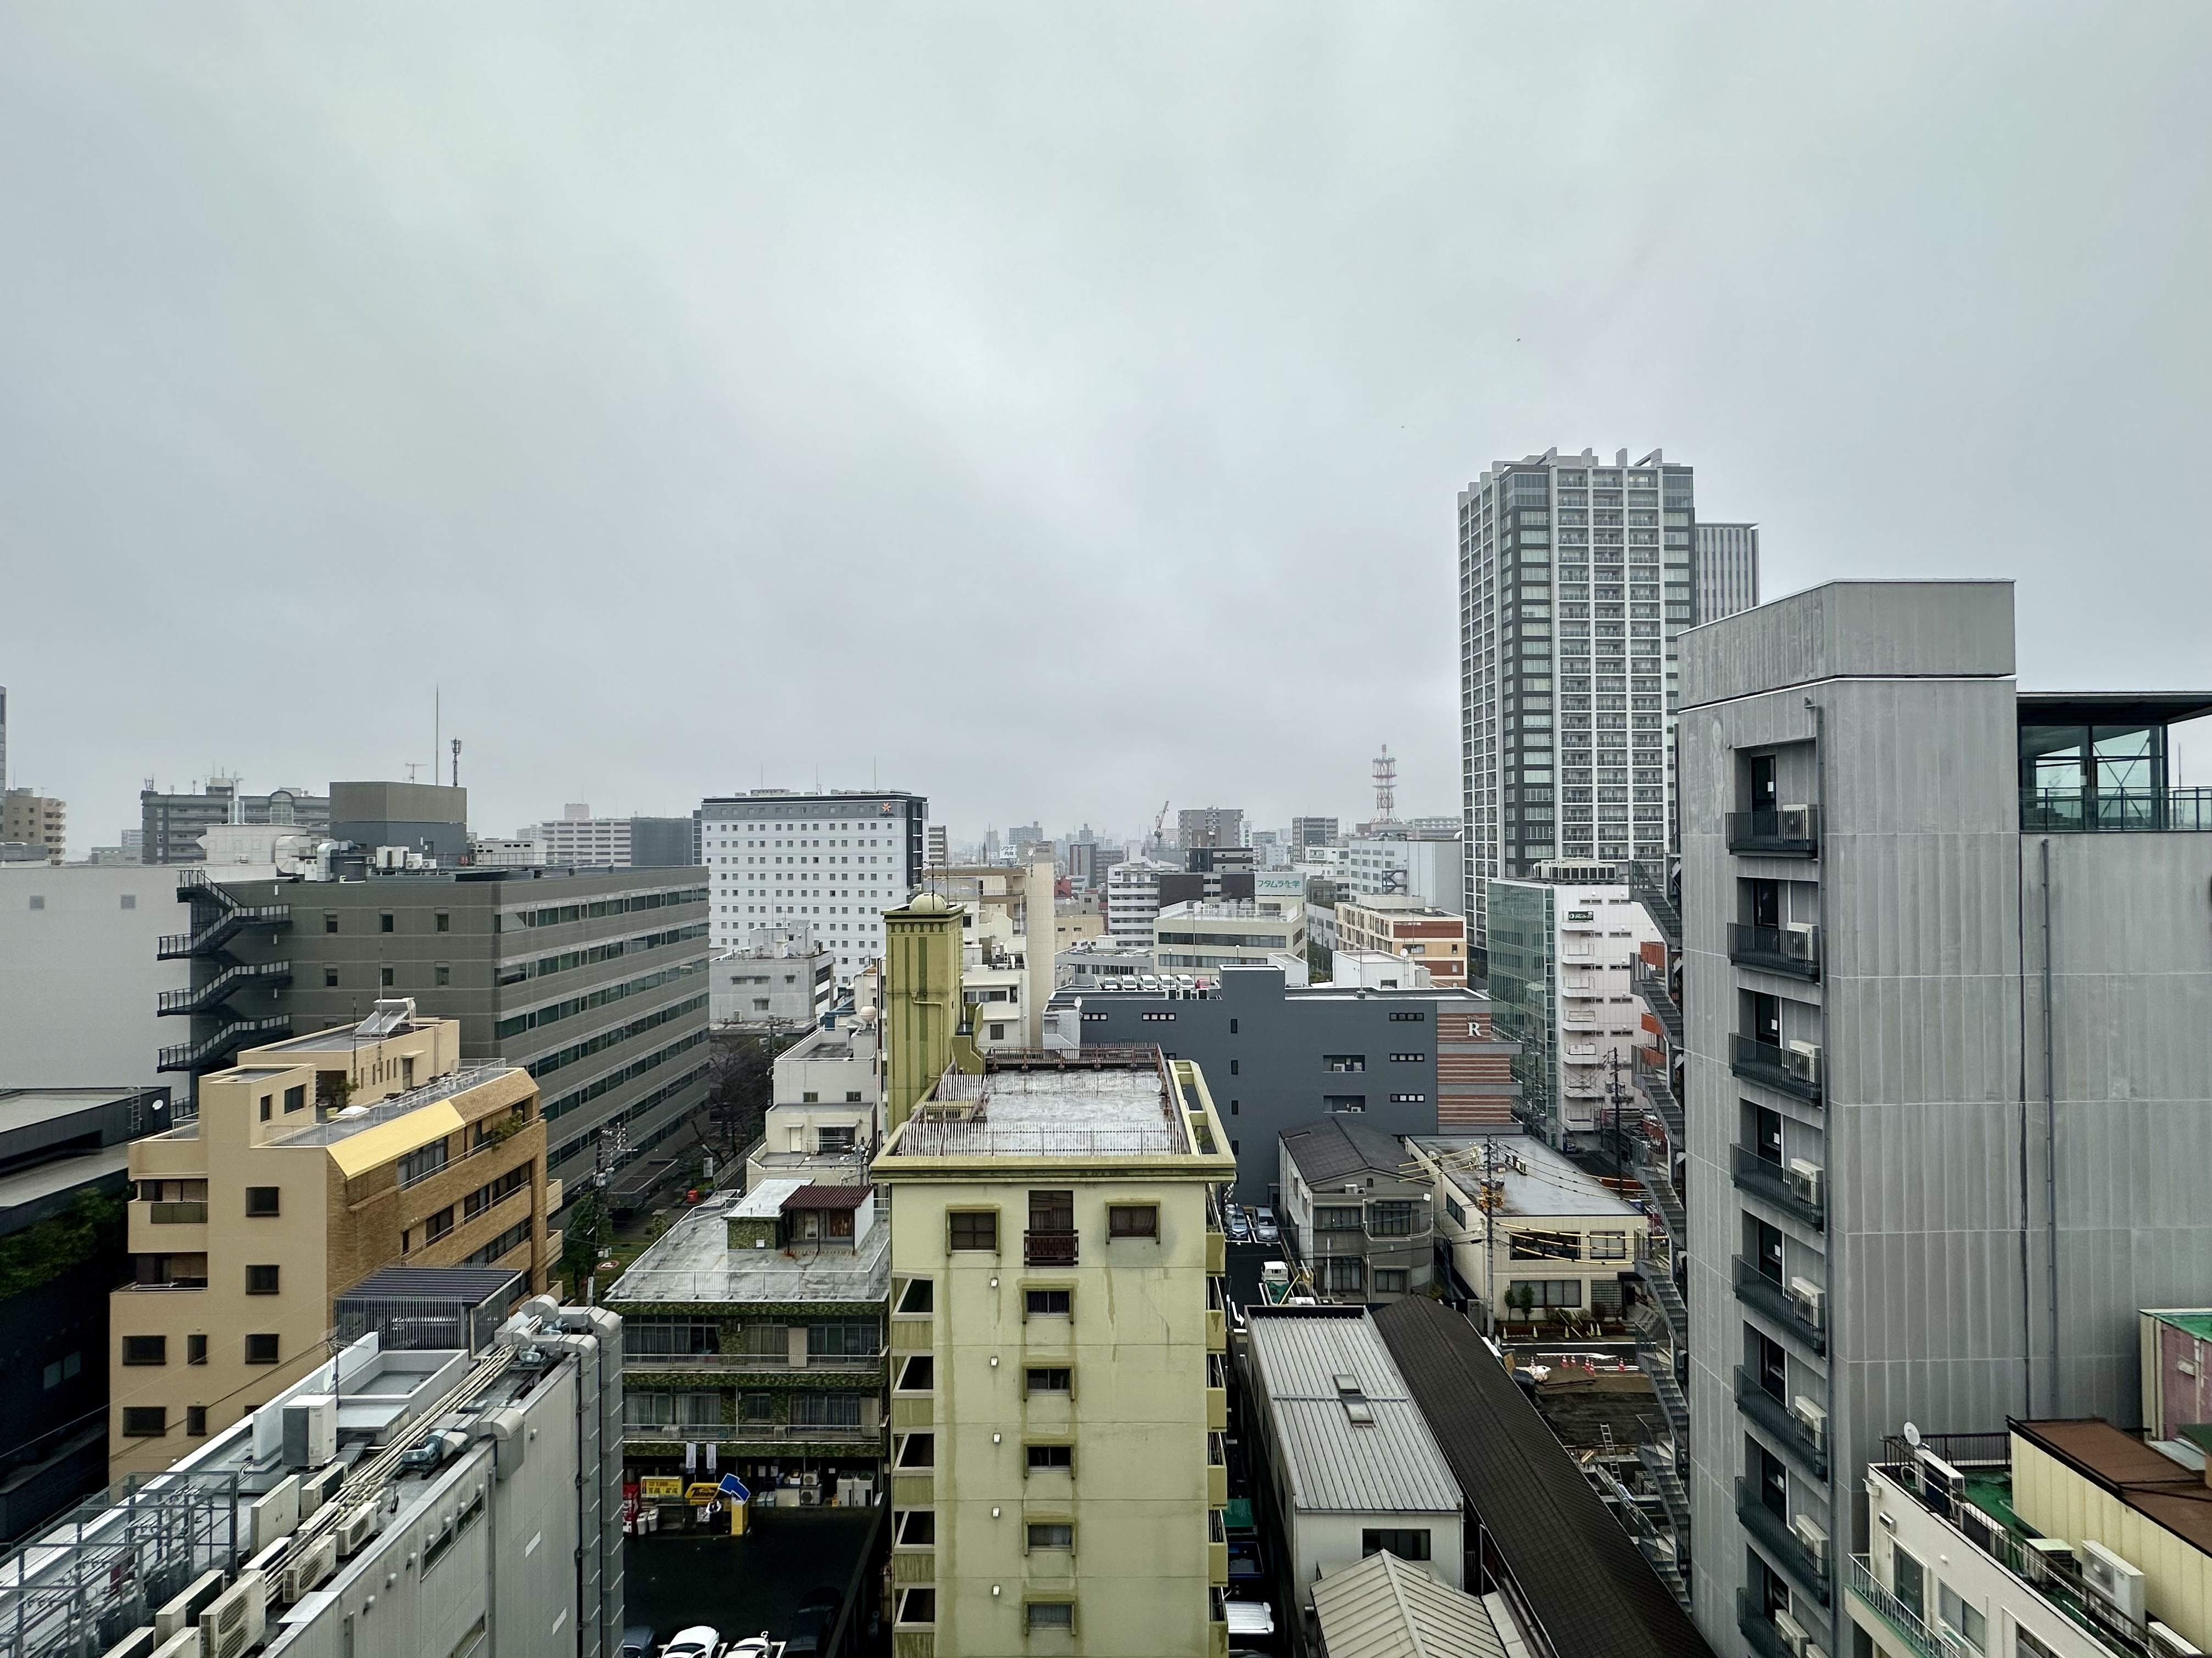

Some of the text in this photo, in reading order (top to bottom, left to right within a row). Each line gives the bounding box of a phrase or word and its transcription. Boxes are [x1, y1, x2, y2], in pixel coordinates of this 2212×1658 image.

[1257, 880, 1300, 888] フタムラ化学
[1467, 1022, 1482, 1037] R
